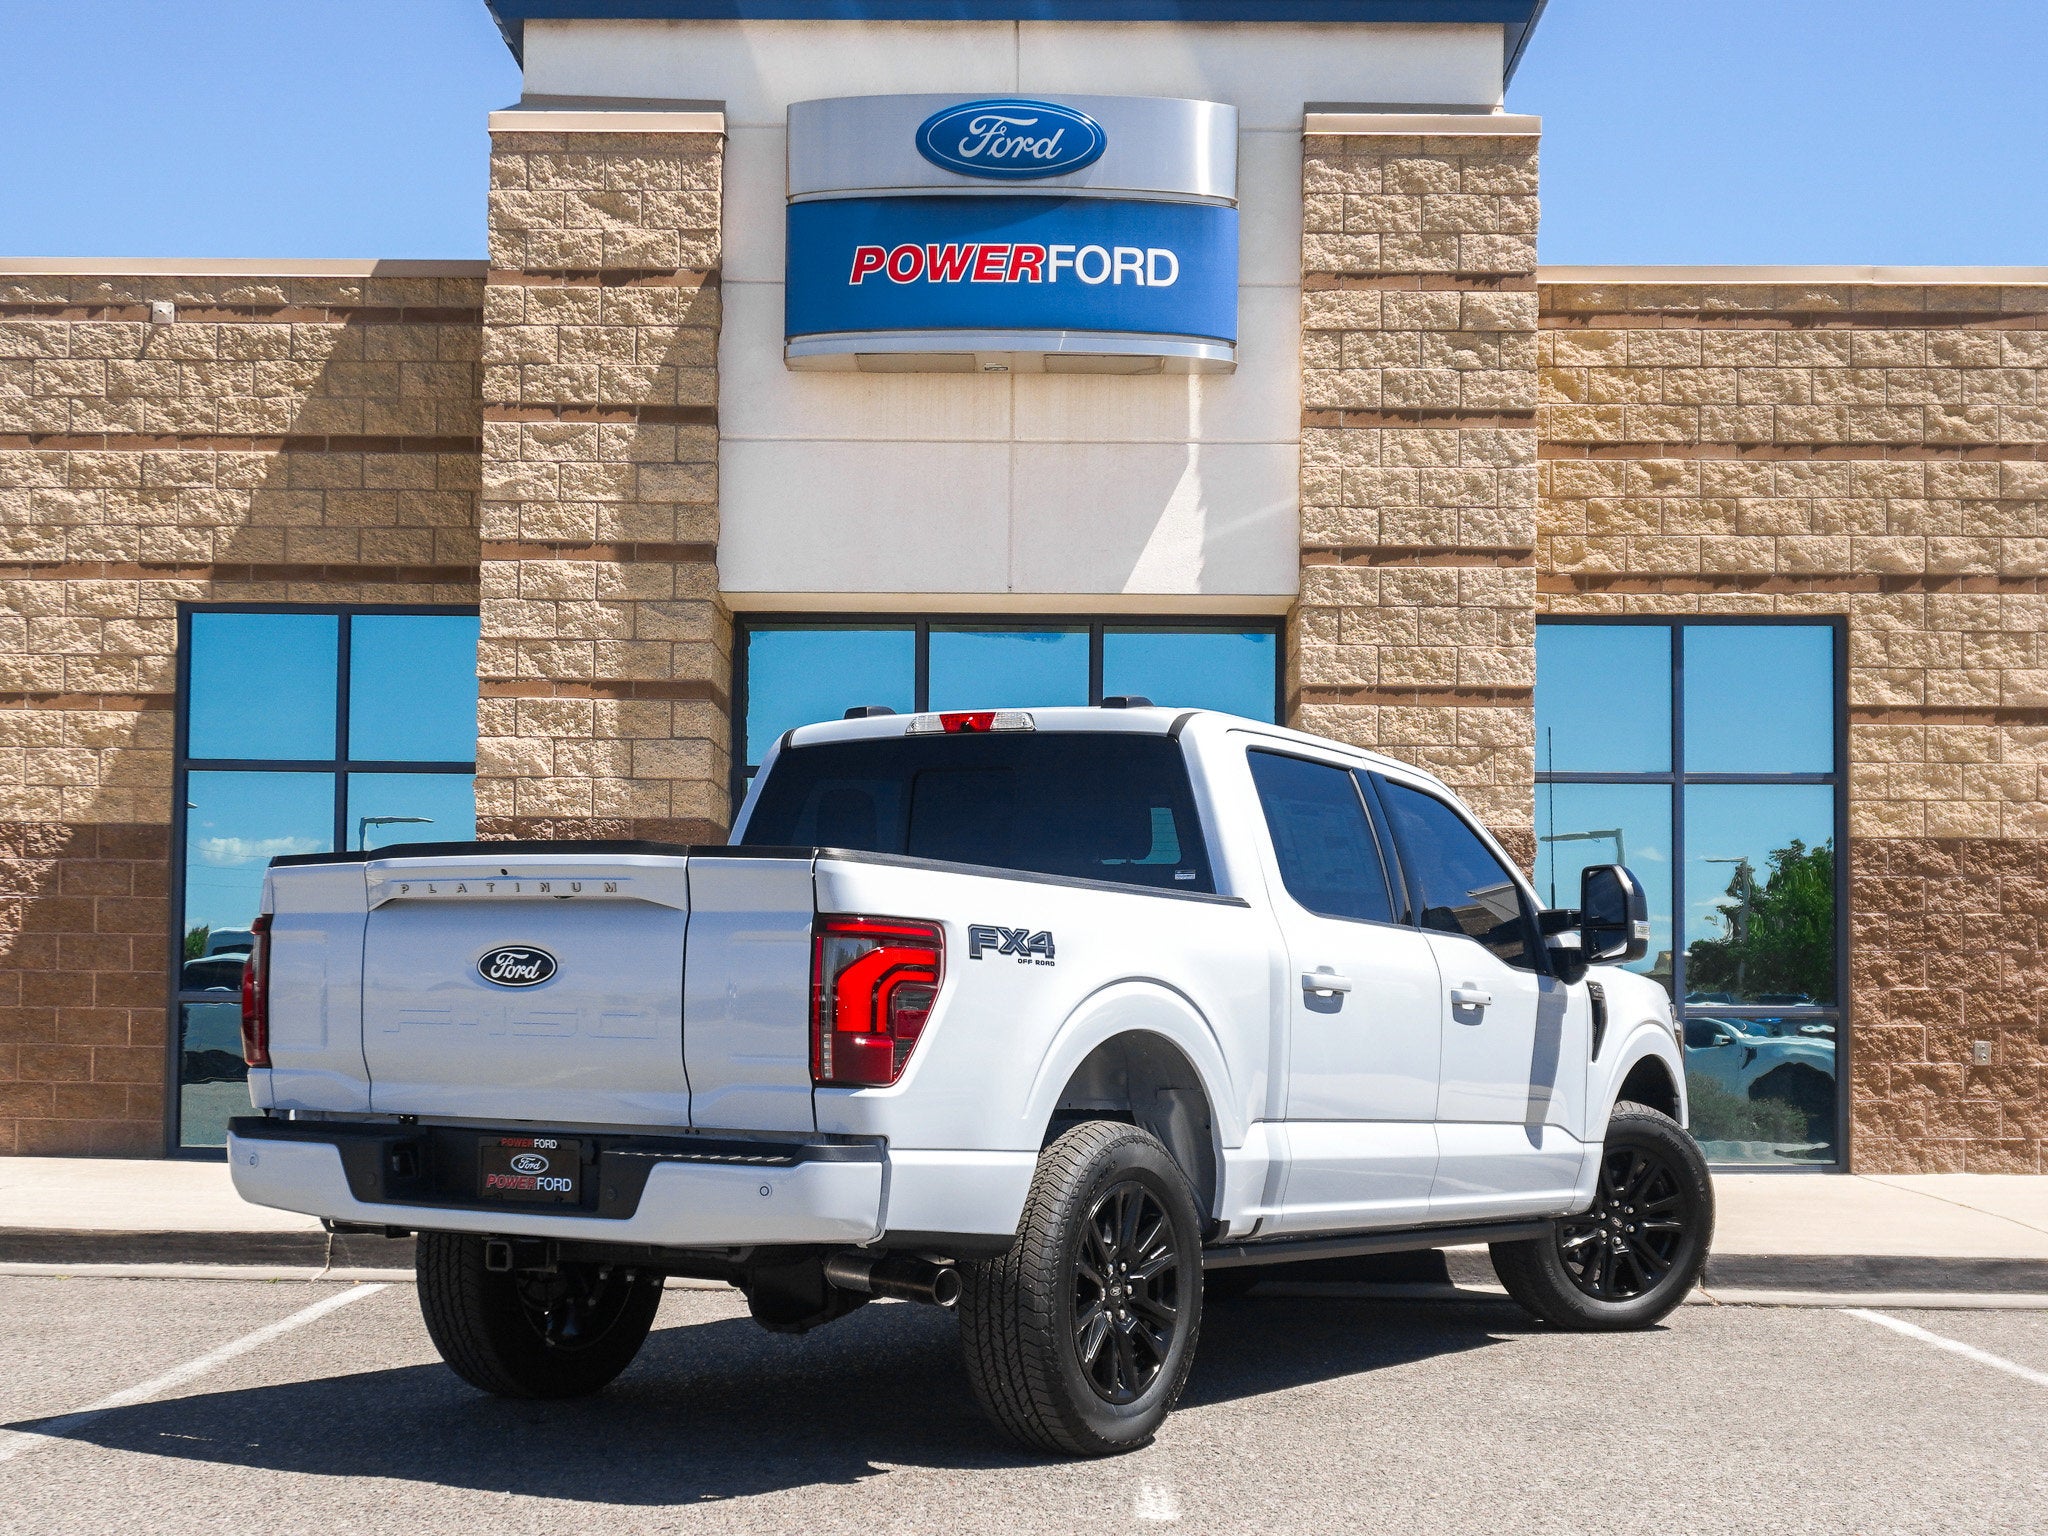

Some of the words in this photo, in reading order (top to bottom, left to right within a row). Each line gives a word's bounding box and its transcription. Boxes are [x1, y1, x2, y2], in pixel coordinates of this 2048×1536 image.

[958, 114, 1065, 159] Ford
[848, 243, 1179, 287] POWERFORD
[400, 881, 617, 894] PLATINUM
[968, 923, 1055, 960] FX4
[490, 952, 541, 980] Ford
[1035, 959, 1055, 967] ROAD
[502, 1138, 557, 1149] POWERFORD
[519, 1157, 541, 1170] Ford
[487, 1174, 572, 1192] POWERFORD
